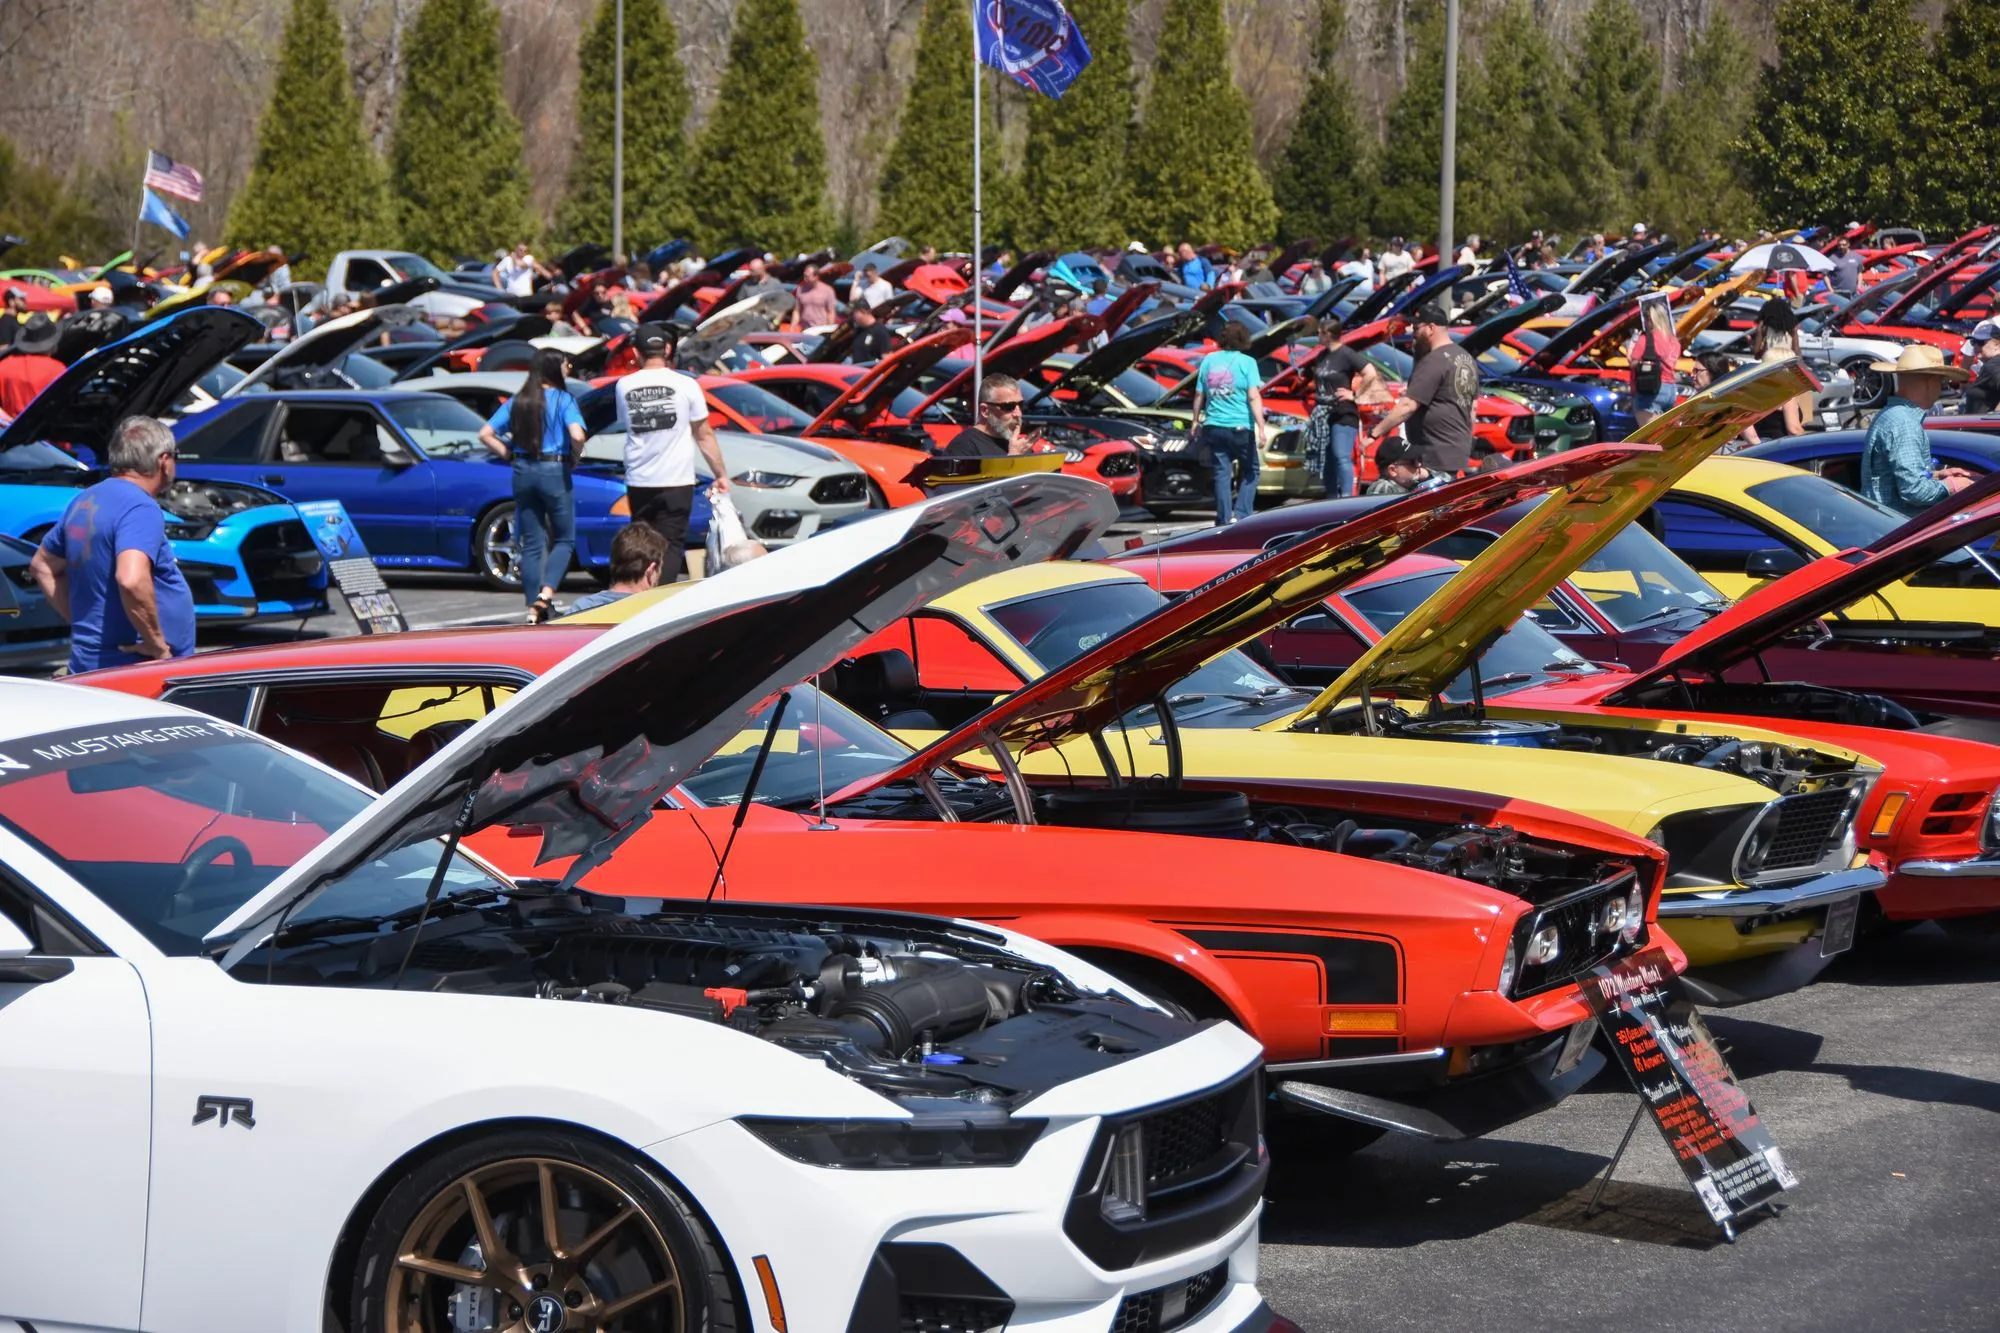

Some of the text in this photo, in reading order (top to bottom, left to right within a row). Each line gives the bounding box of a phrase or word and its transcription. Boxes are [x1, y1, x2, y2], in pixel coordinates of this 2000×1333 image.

[1185, 549, 1277, 601] 351 RAM AIR
[1598, 977, 1620, 1000] 1972
[1613, 970, 1650, 995] Mustang
